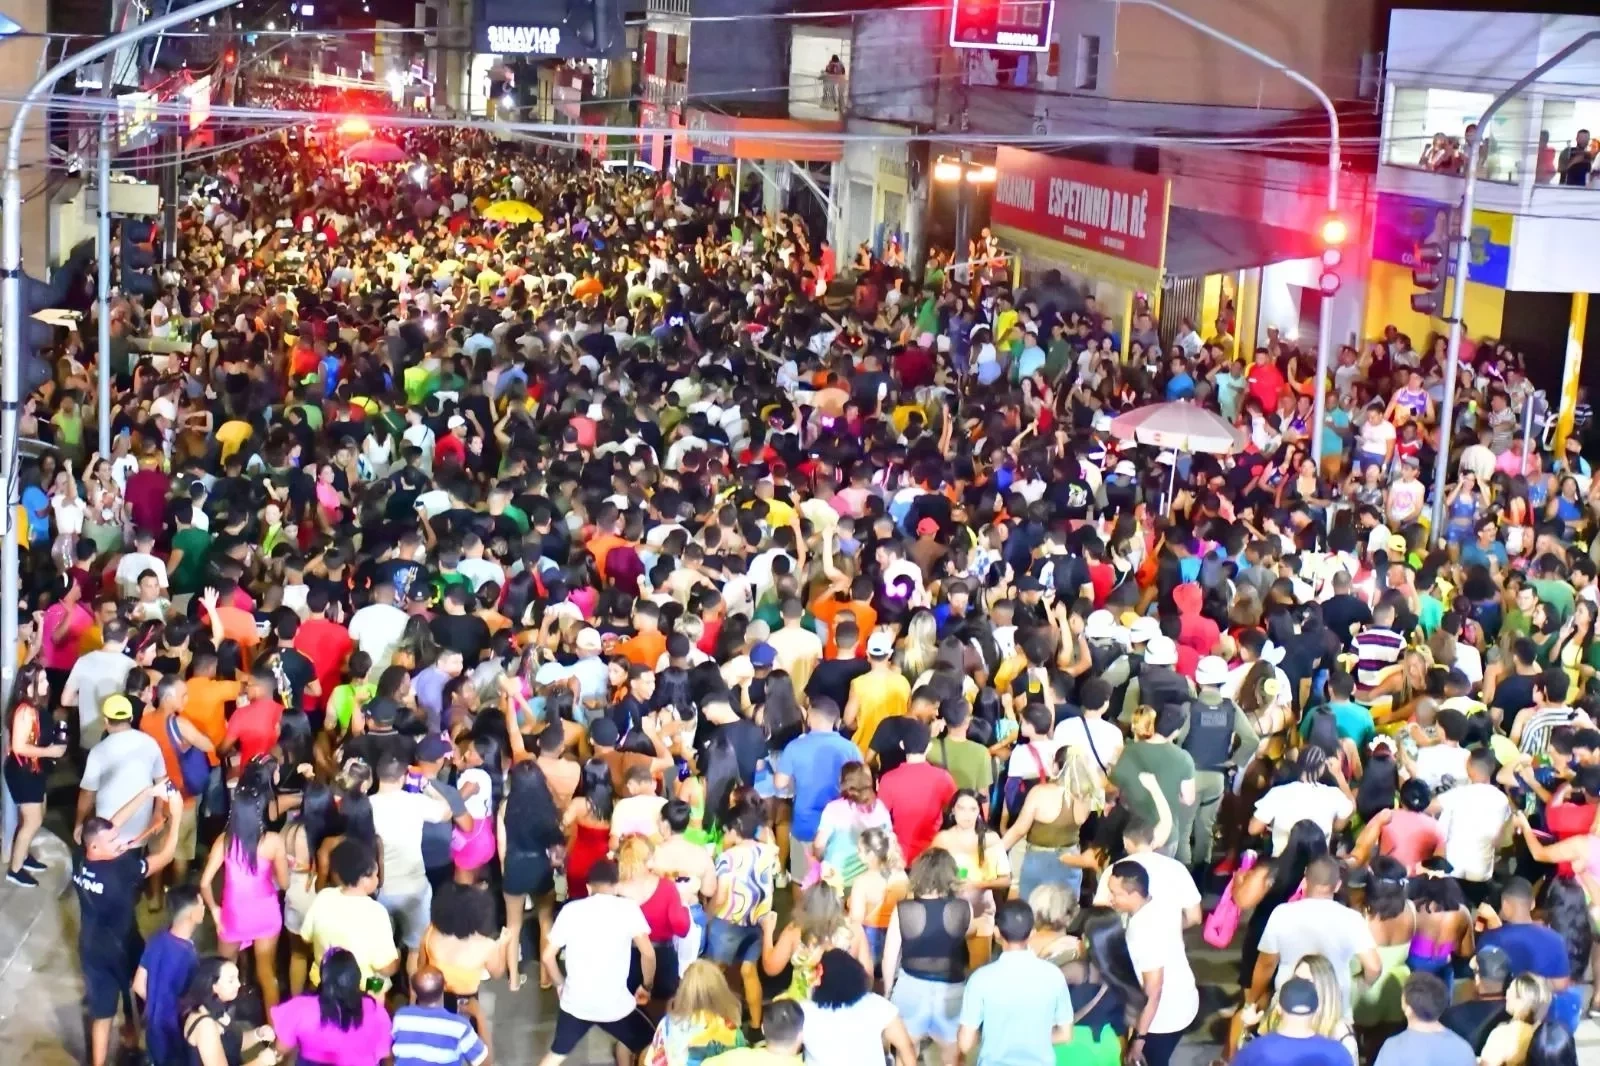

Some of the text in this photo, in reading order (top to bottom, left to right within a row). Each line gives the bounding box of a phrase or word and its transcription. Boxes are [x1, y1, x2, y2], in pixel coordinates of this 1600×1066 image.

[487, 25, 560, 44] SINAVIAS
[1048, 177, 1148, 238] ESPETINHO DA RÊ
